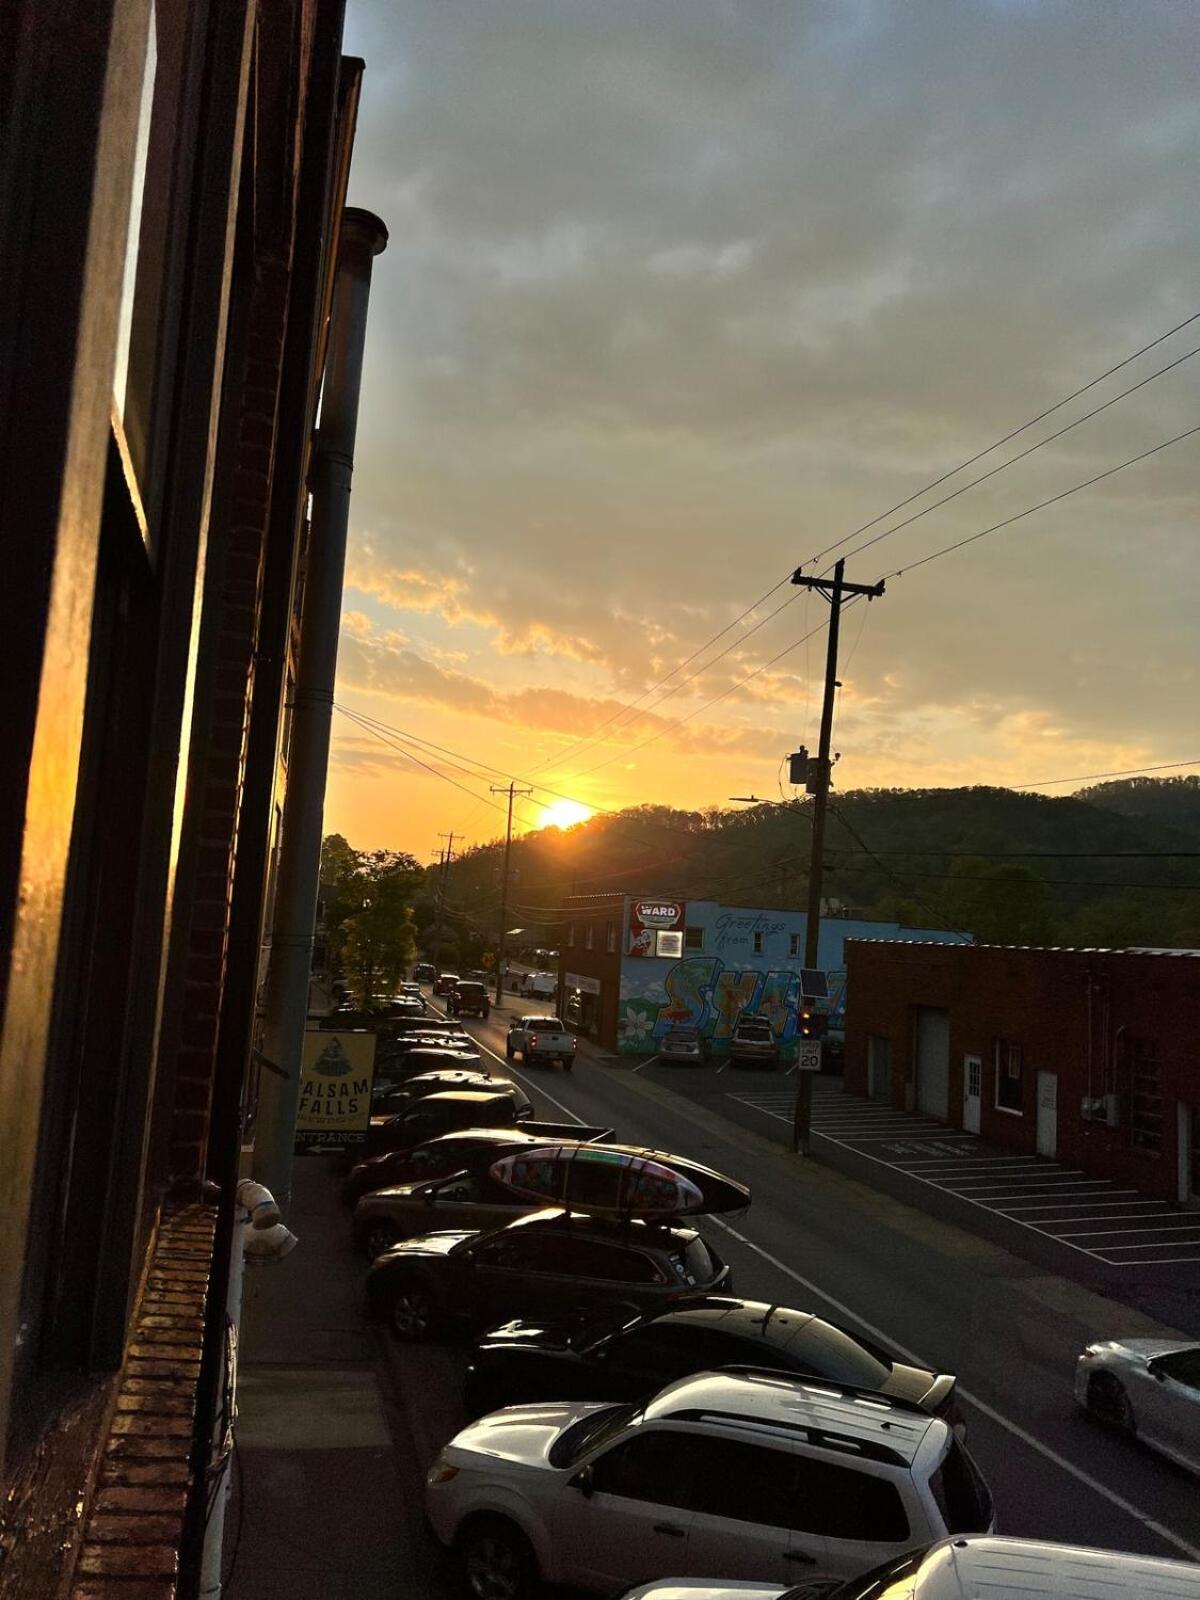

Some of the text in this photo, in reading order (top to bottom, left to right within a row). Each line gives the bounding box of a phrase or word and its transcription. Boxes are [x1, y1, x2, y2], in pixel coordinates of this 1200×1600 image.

[641, 905, 676, 916] WARD
[801, 1055, 818, 1066] 20
[301, 1079, 369, 1098] ALSAM
[299, 1097, 358, 1115] FALLS
[296, 1132, 367, 1143] NTRANCE
